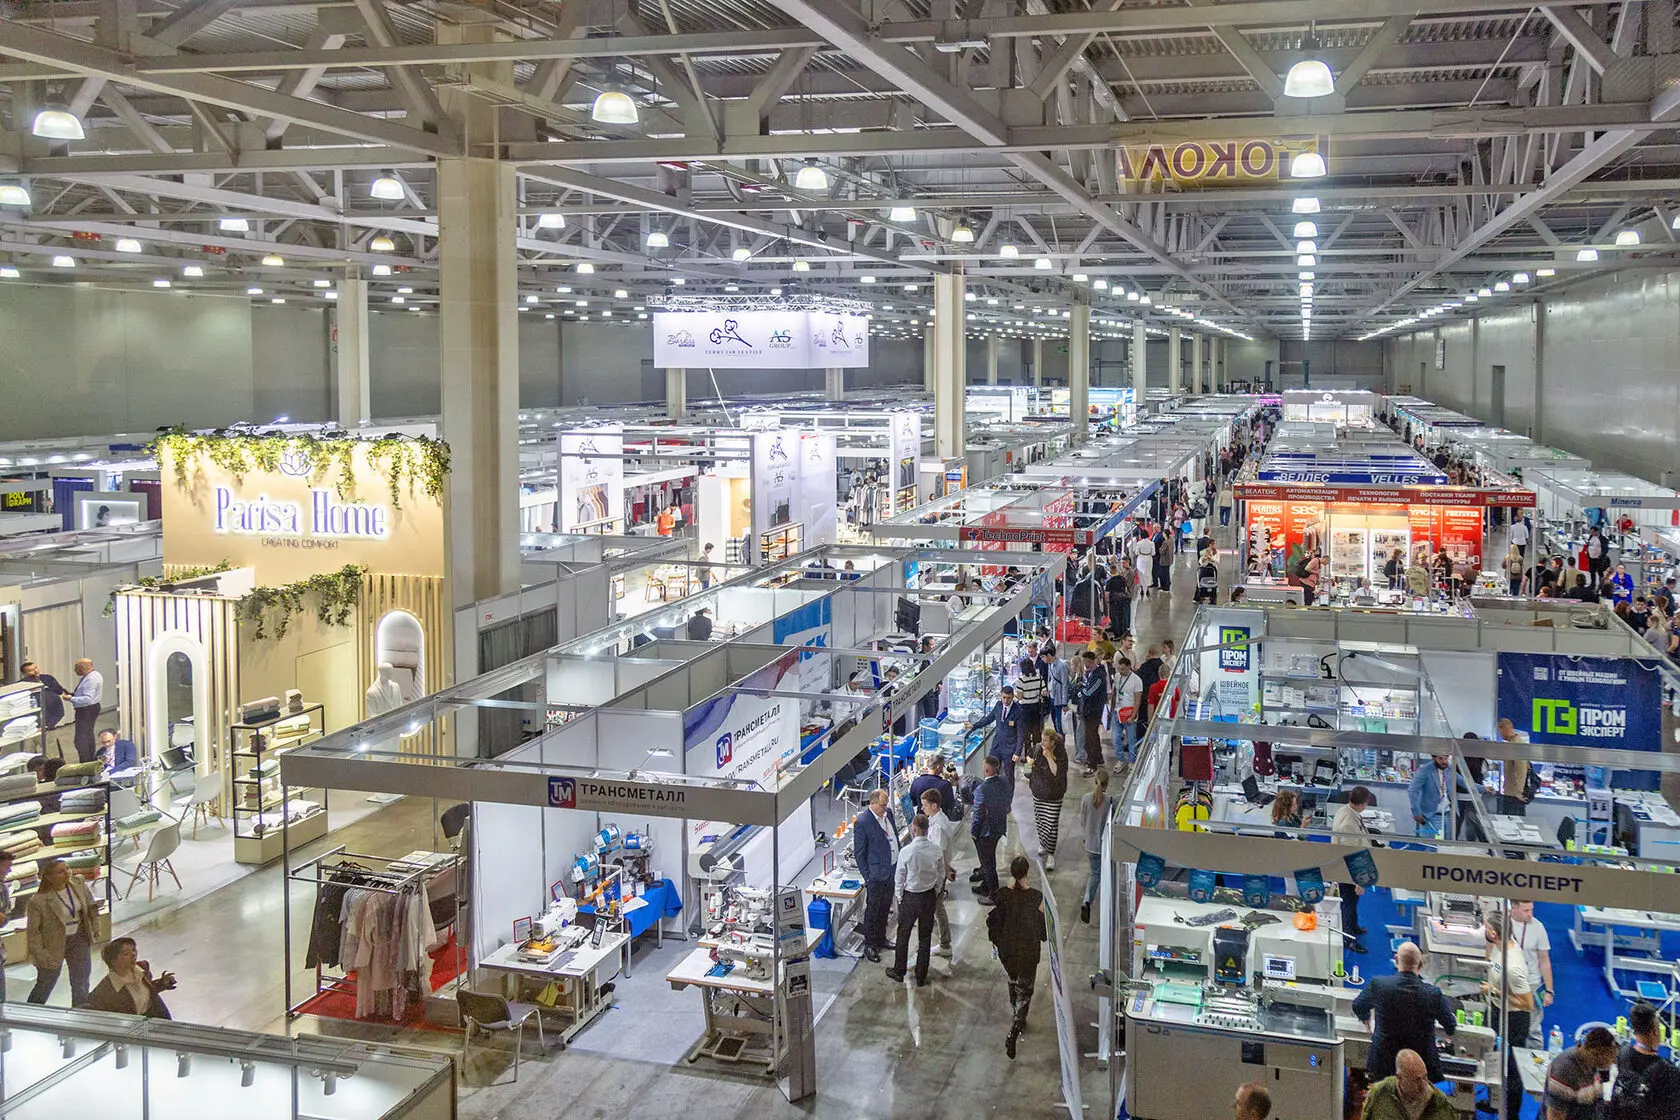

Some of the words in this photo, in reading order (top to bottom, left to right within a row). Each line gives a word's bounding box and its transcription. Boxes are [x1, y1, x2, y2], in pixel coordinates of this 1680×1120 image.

[1280, 473, 1330, 482] ВЕЛЛЕС
[1371, 474, 1419, 485] VELLES
[9, 491, 25, 499] POLY
[1611, 497, 1642, 505] Minerva
[216, 487, 299, 533] Parisa
[311, 490, 384, 536] Home
[1291, 505, 1318, 515] SBS
[980, 529, 1046, 542] TechnoPrint
[302, 538, 339, 549] COMFORT
[1222, 650, 1247, 660] ПРОМ
[1222, 659, 1247, 667] ЭКСПЕРТ
[1220, 680, 1249, 690] ШВЕЙНОЕ
[1580, 708, 1626, 727] ПРОМ
[1580, 725, 1626, 738] ЭКСПЕРТ
[581, 783, 685, 803] ТРАНСМЕТАЛЛ
[1422, 864, 1584, 893] ПРОМЭКСПЕРТ
